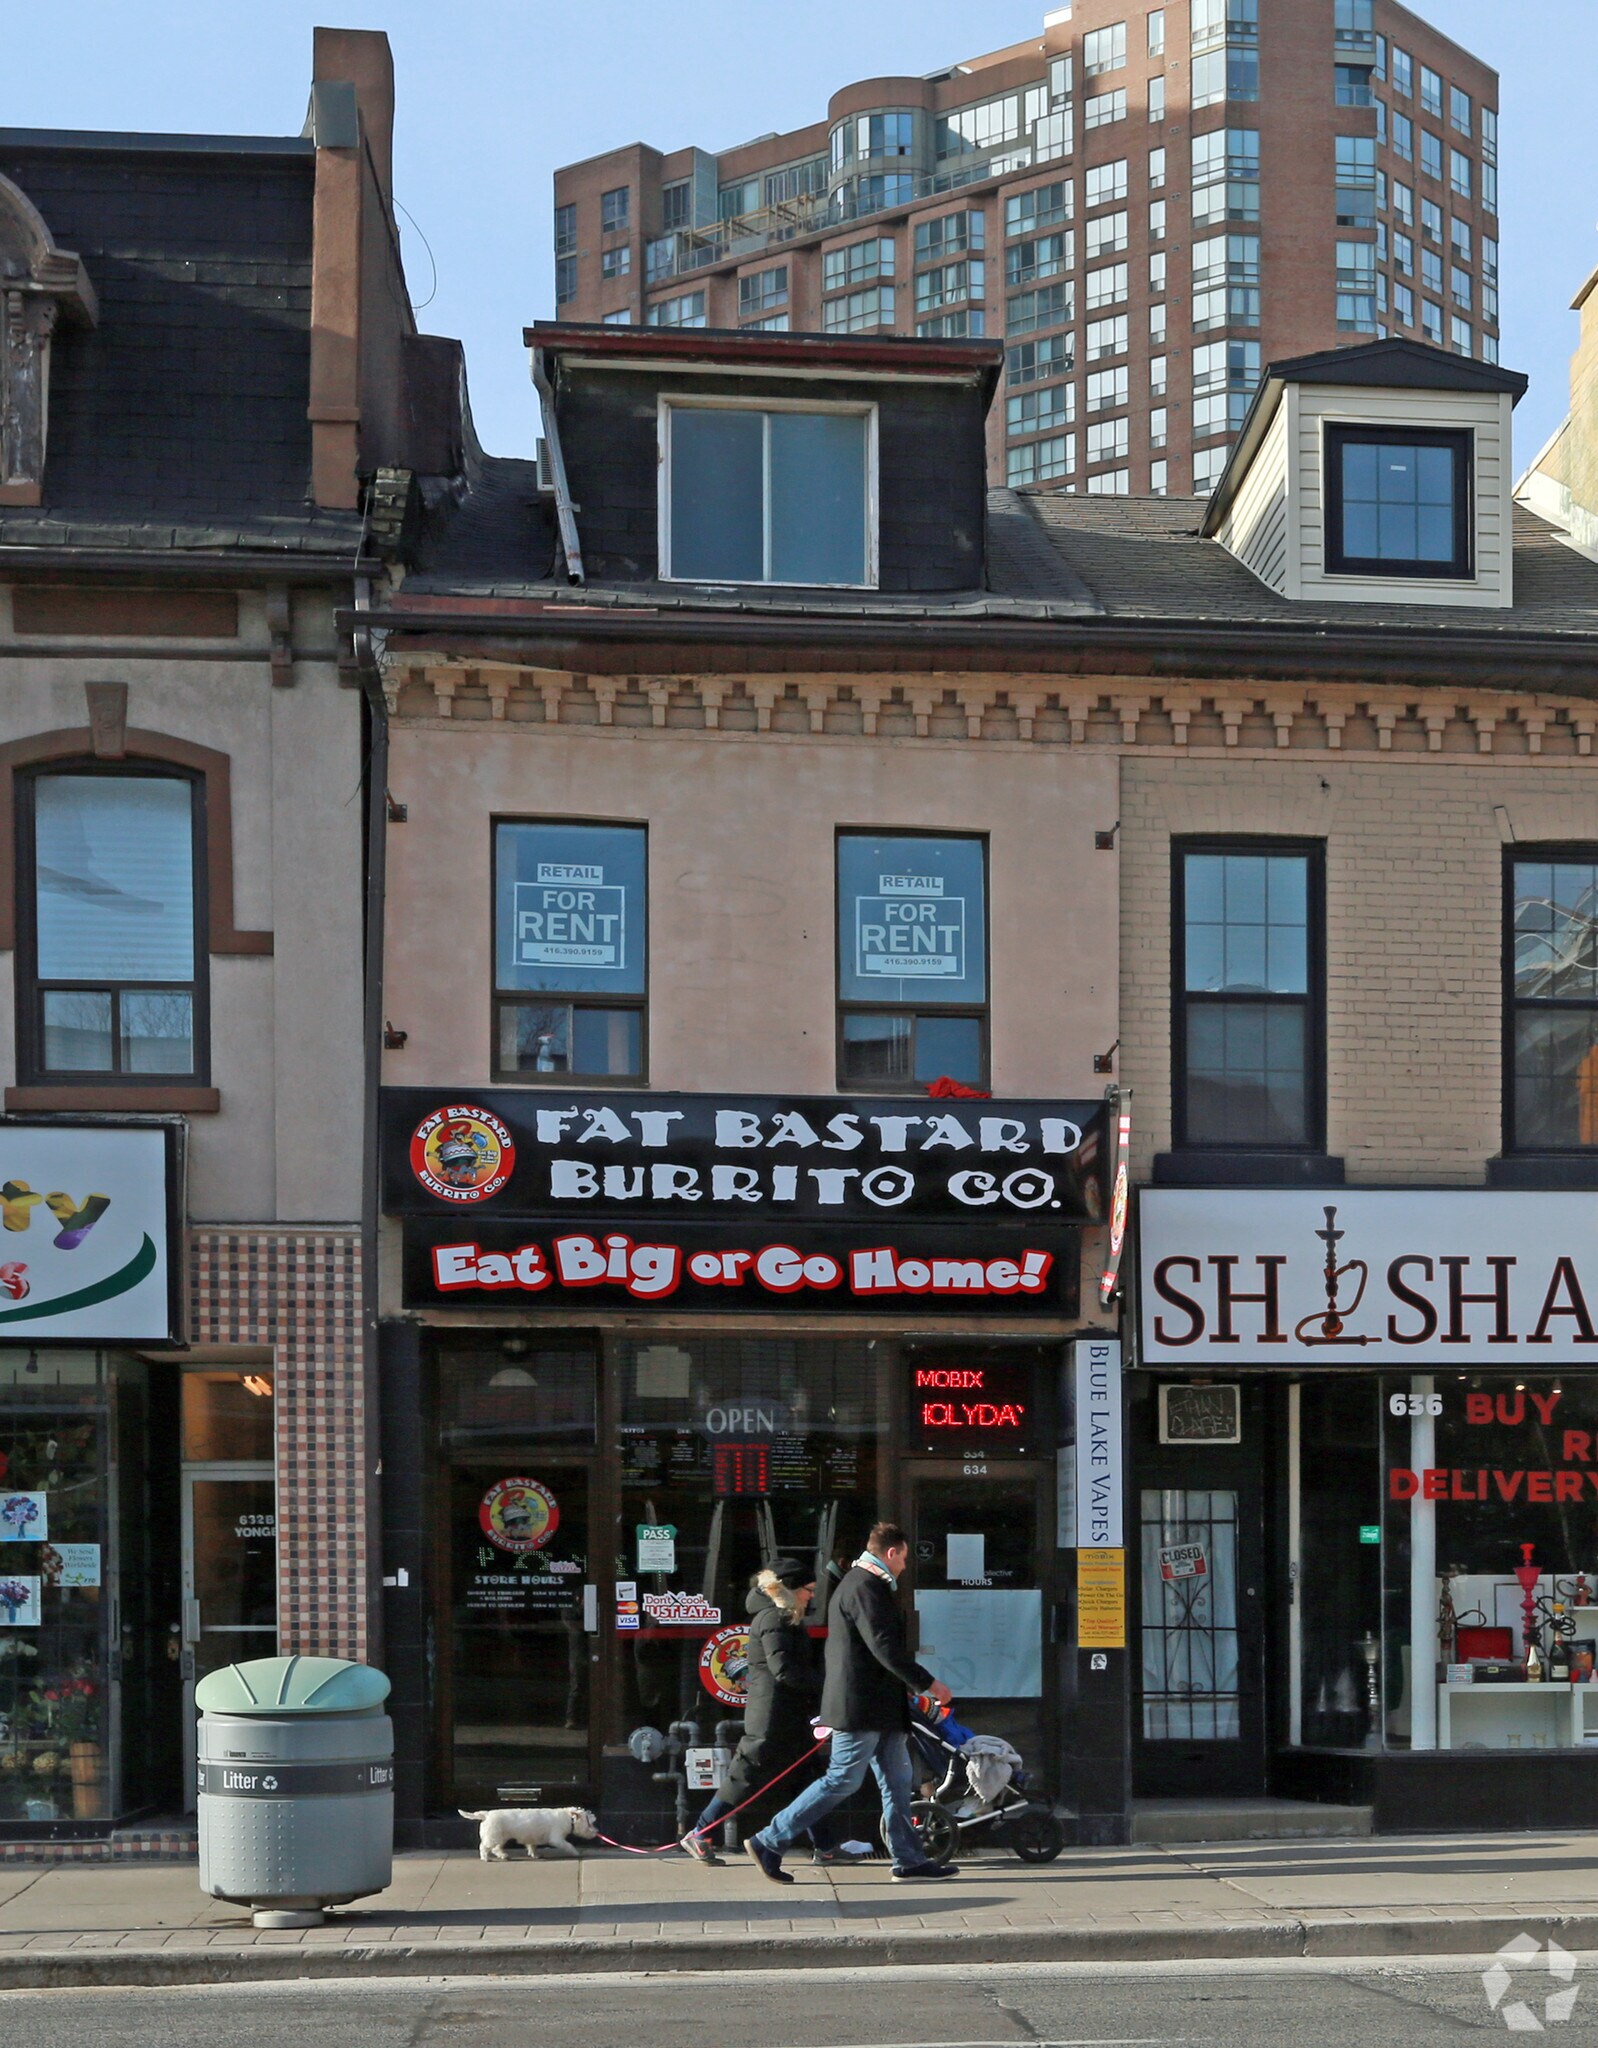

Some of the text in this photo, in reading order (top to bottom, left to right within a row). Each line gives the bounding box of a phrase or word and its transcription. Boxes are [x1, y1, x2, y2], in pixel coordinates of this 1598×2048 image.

[541, 866, 599, 878] RETAIL
[883, 876, 941, 888] RETAIL
[543, 890, 595, 910] FOR
[885, 904, 936, 922] FOR
[519, 911, 618, 942] RENT
[862, 924, 960, 953] RENT
[544, 947, 602, 955] 416.390.9159
[417, 1107, 512, 1149] FAT BASTARD
[537, 1106, 1082, 1154] FAT BASTARD
[419, 1169, 506, 1200] BURRITO CO.
[551, 1160, 915, 1207] BURRITO
[948, 1168, 1061, 1208] CO.
[435, 1236, 1047, 1292] Eat Big or Go Home!
[916, 1370, 984, 1388] MOBIX
[1090, 1345, 1109, 1401] BLUE
[1389, 1393, 1443, 1416] 636
[1466, 1394, 1562, 1425] BUY
[706, 1408, 774, 1434] OPEN
[1091, 1411, 1110, 1466] LAKE
[1563, 1430, 1598, 1462] R
[963, 1465, 987, 1475] 634
[1091, 1474, 1111, 1542] VAPES
[239, 1514, 274, 1525] 632B
[234, 1527, 277, 1537] YONGE
[643, 1529, 670, 1539] PASS
[1162, 1547, 1200, 1564] CLOSED
[474, 1575, 564, 1584] STORE HOURS
[961, 1578, 992, 1586] HOURS
[645, 1595, 706, 1604] Don't cook
[701, 1625, 751, 1667] FAT BAST
[716, 1690, 748, 1704] BURR
[223, 1770, 258, 1789] Litter
[370, 1767, 388, 1784] Litter
